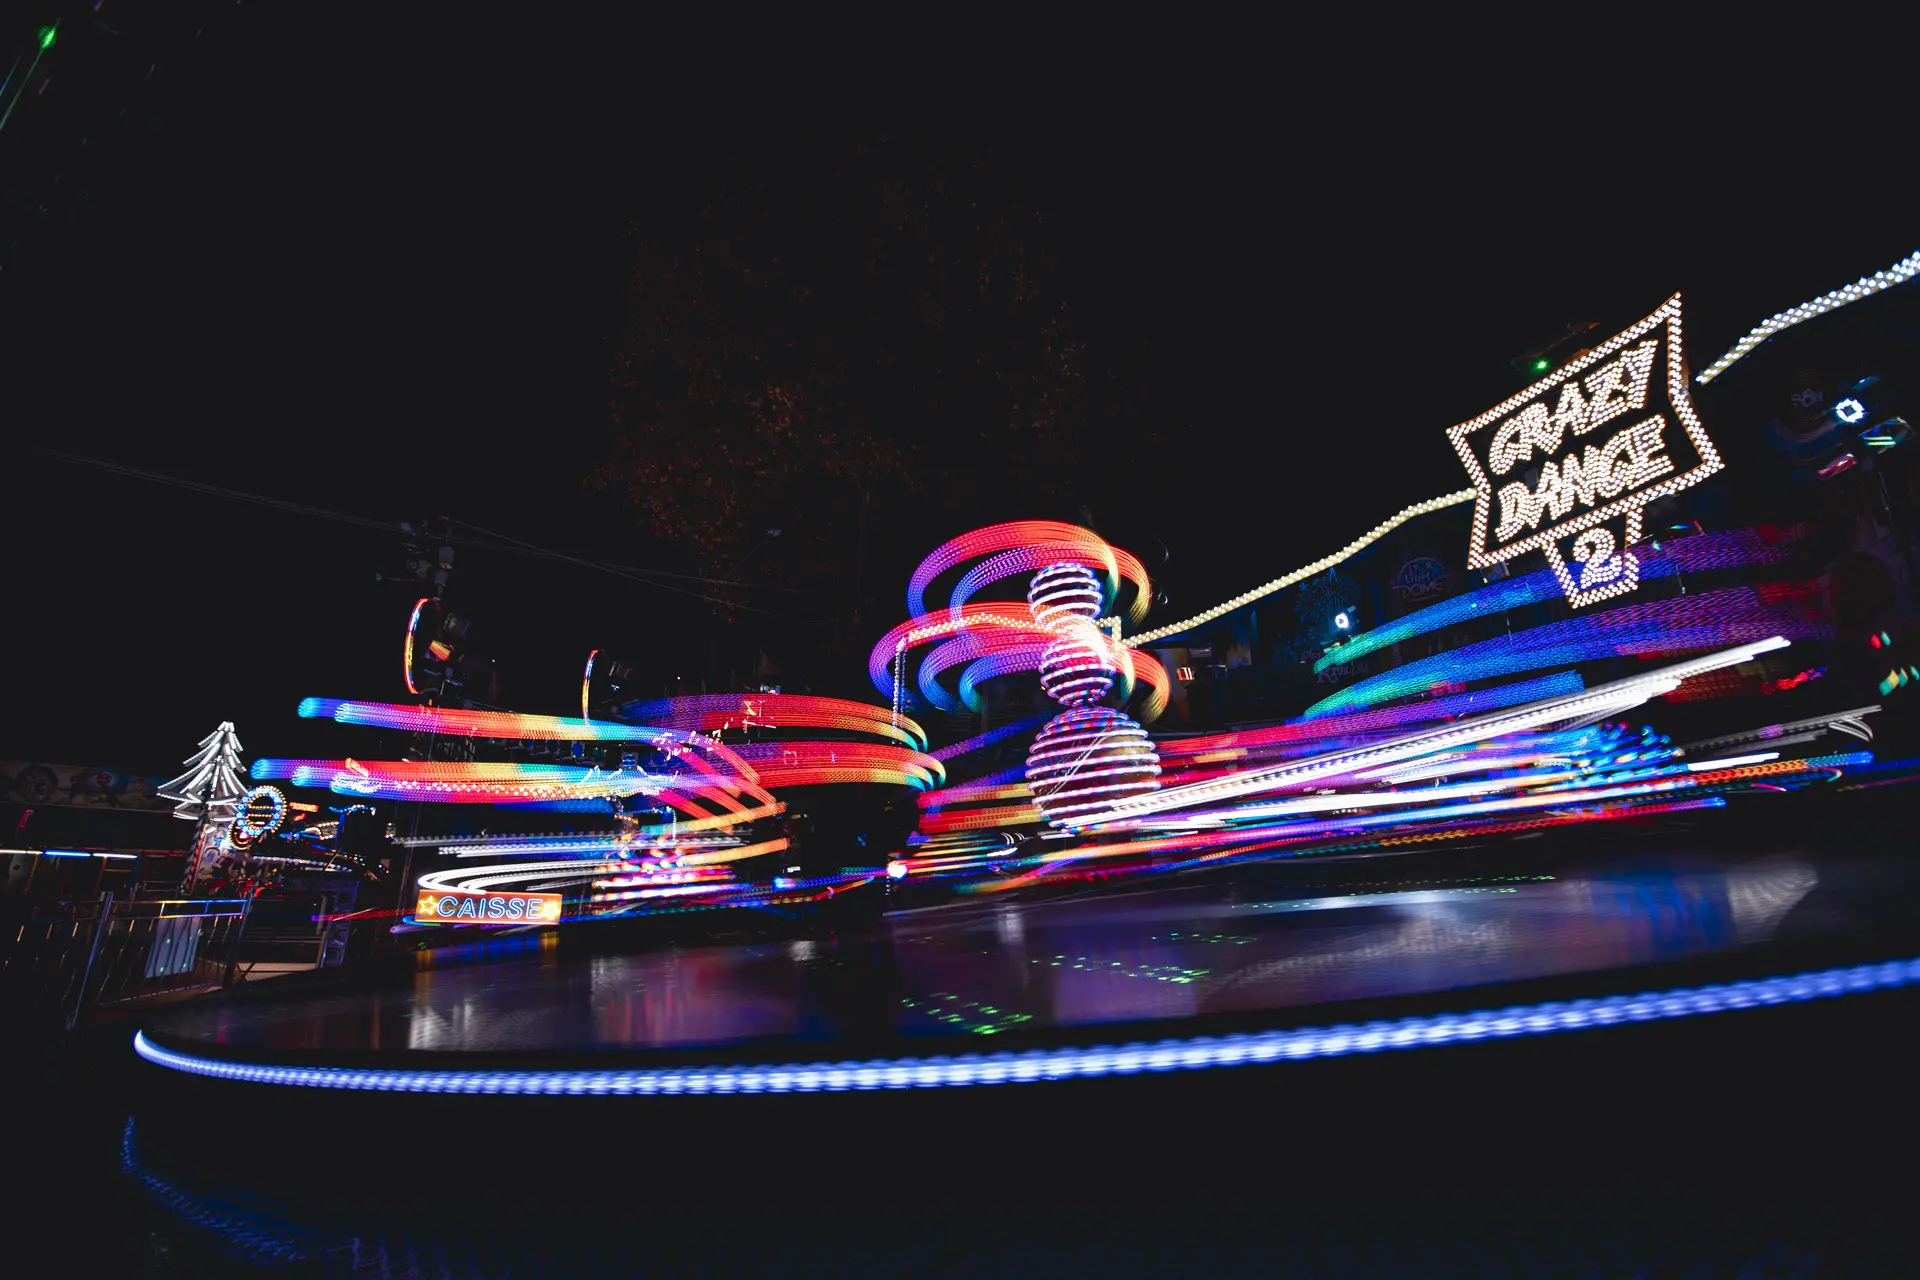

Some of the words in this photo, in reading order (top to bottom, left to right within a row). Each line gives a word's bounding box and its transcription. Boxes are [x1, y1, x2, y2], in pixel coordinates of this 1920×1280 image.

[1488, 338, 1659, 476] CRAZY
[1495, 412, 1675, 543] DANCE
[1572, 527, 1622, 590] 2
[436, 895, 544, 920] CAISSE
